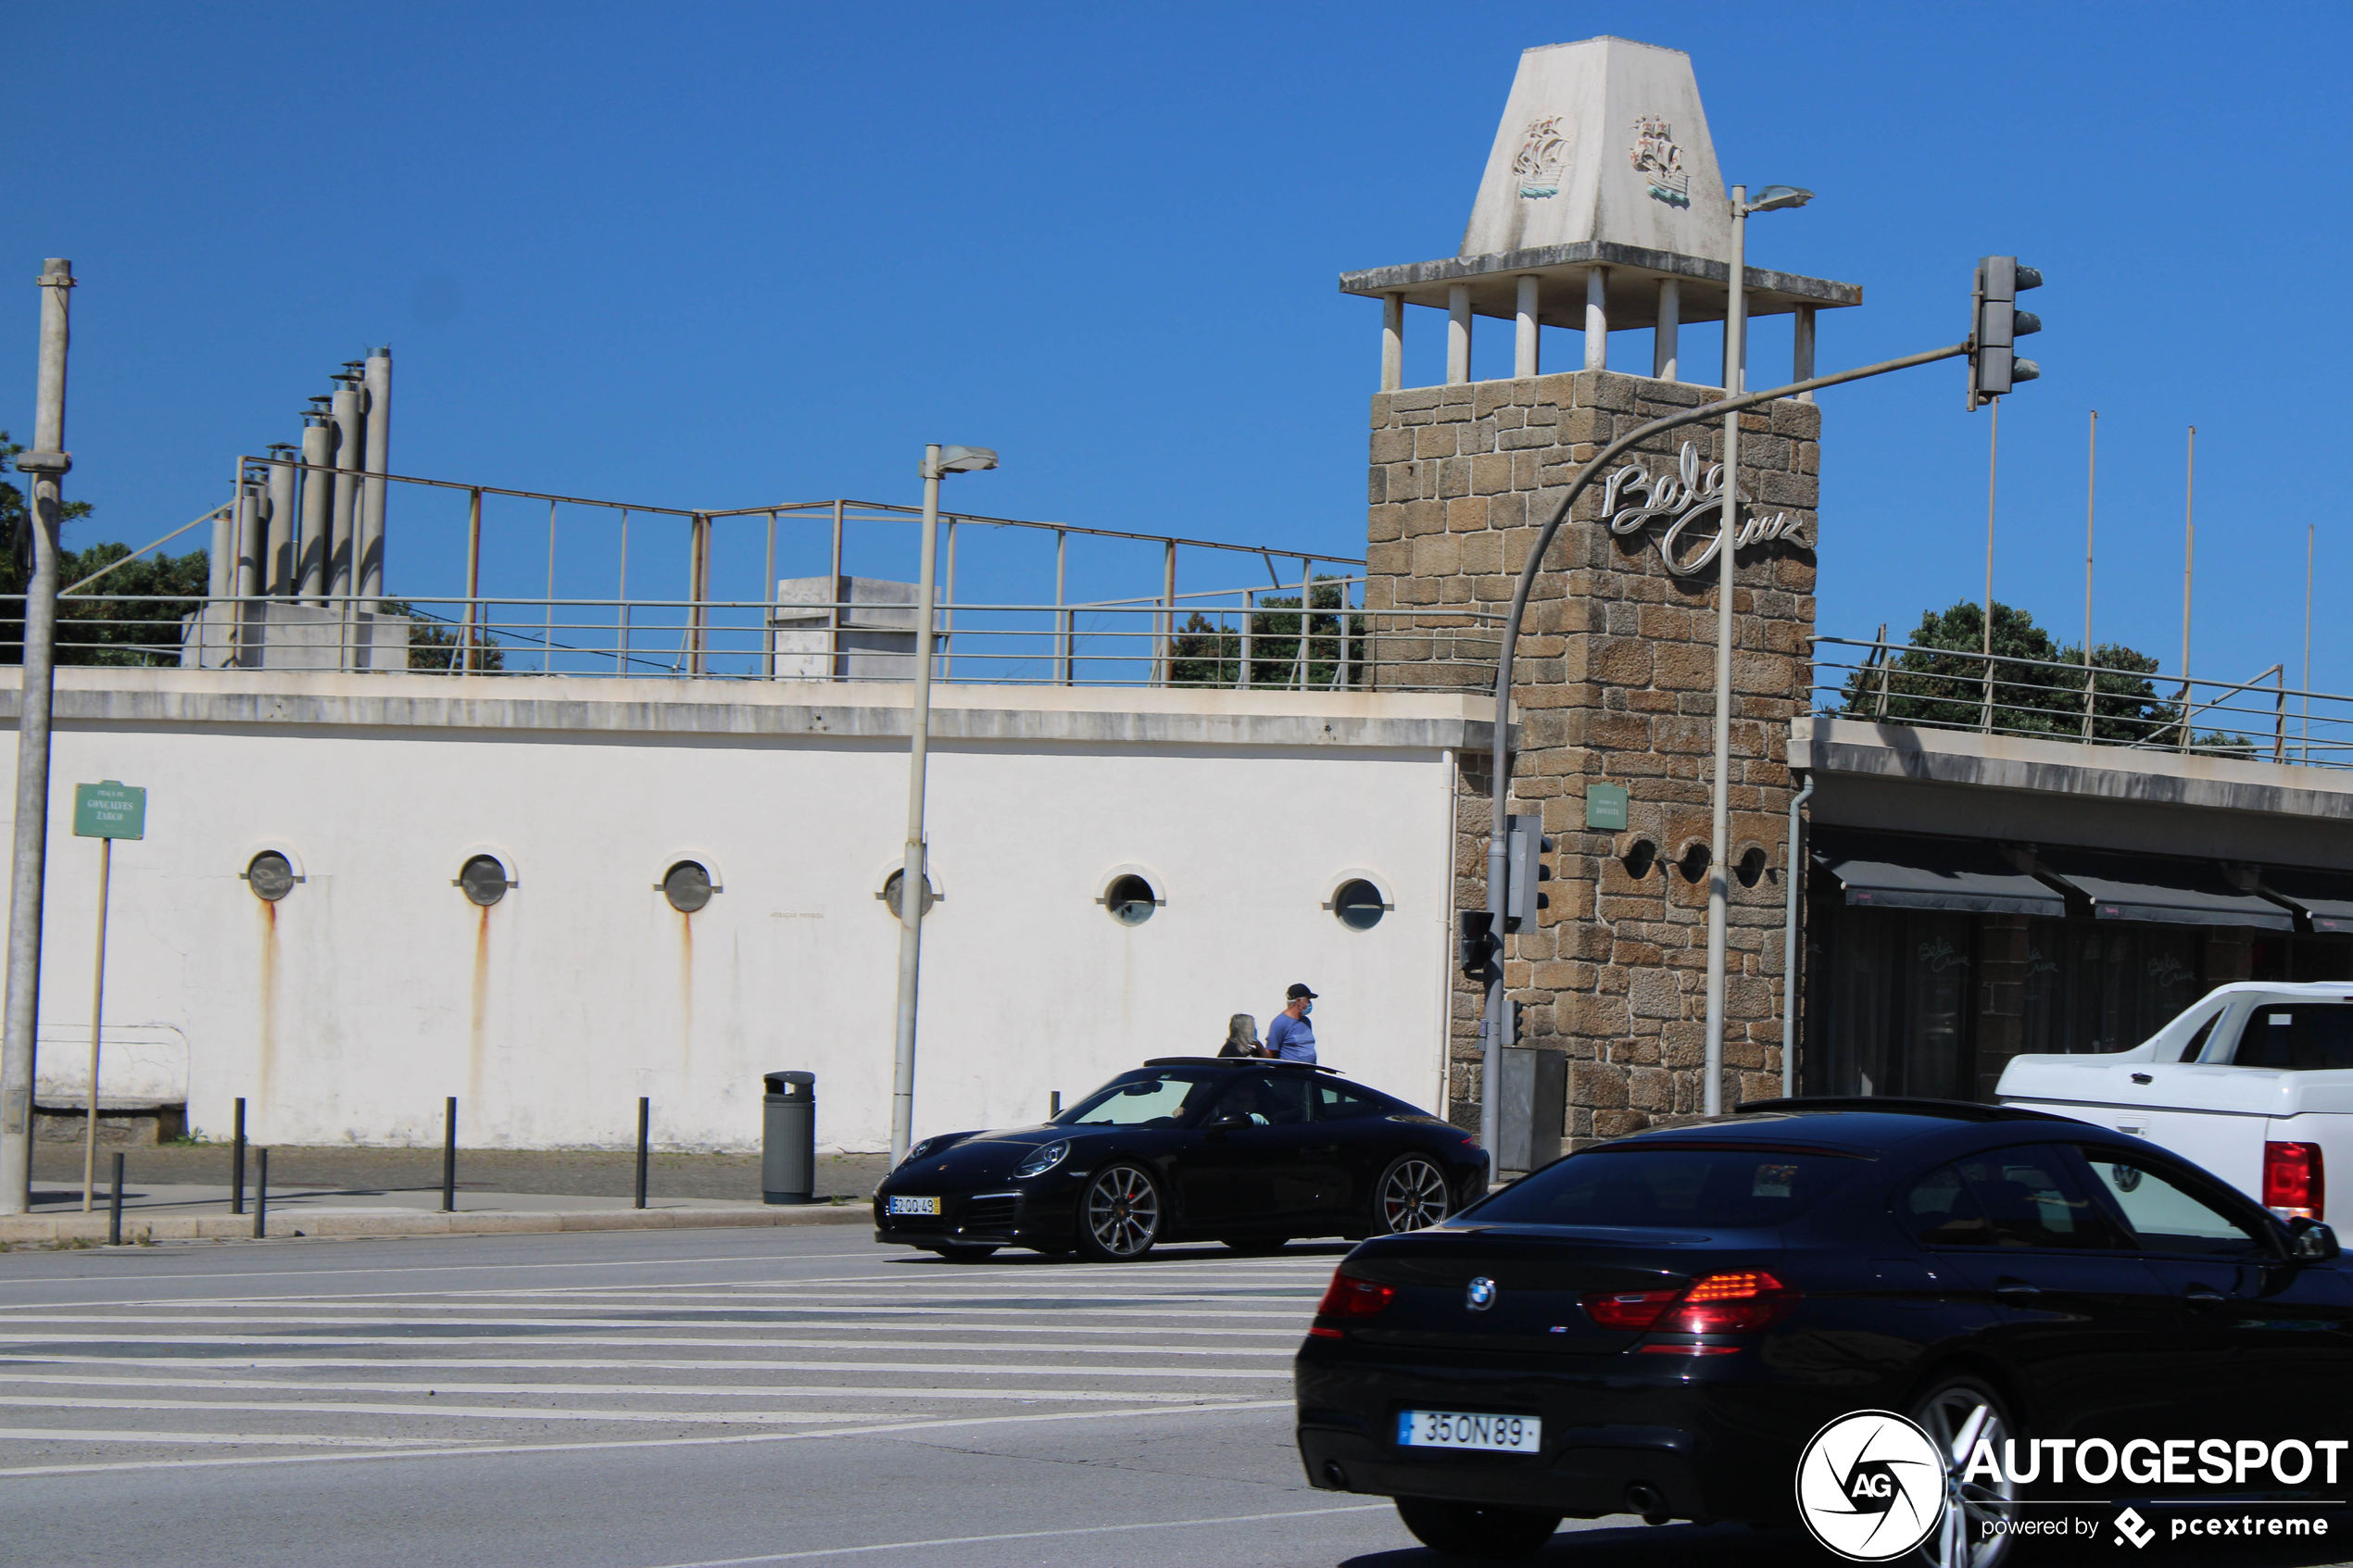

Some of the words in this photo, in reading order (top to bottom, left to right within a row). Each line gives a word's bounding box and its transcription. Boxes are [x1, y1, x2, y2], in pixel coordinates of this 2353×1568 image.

[1601, 440, 1752, 534] Bela
[87, 799, 133, 810] GONÇALVES
[96, 811, 123, 821] ZARCO
[1919, 936, 1954, 960] Bela
[1931, 953, 1971, 972] Cruz
[2147, 953, 2182, 976] Bela
[2159, 969, 2196, 987] Cruz
